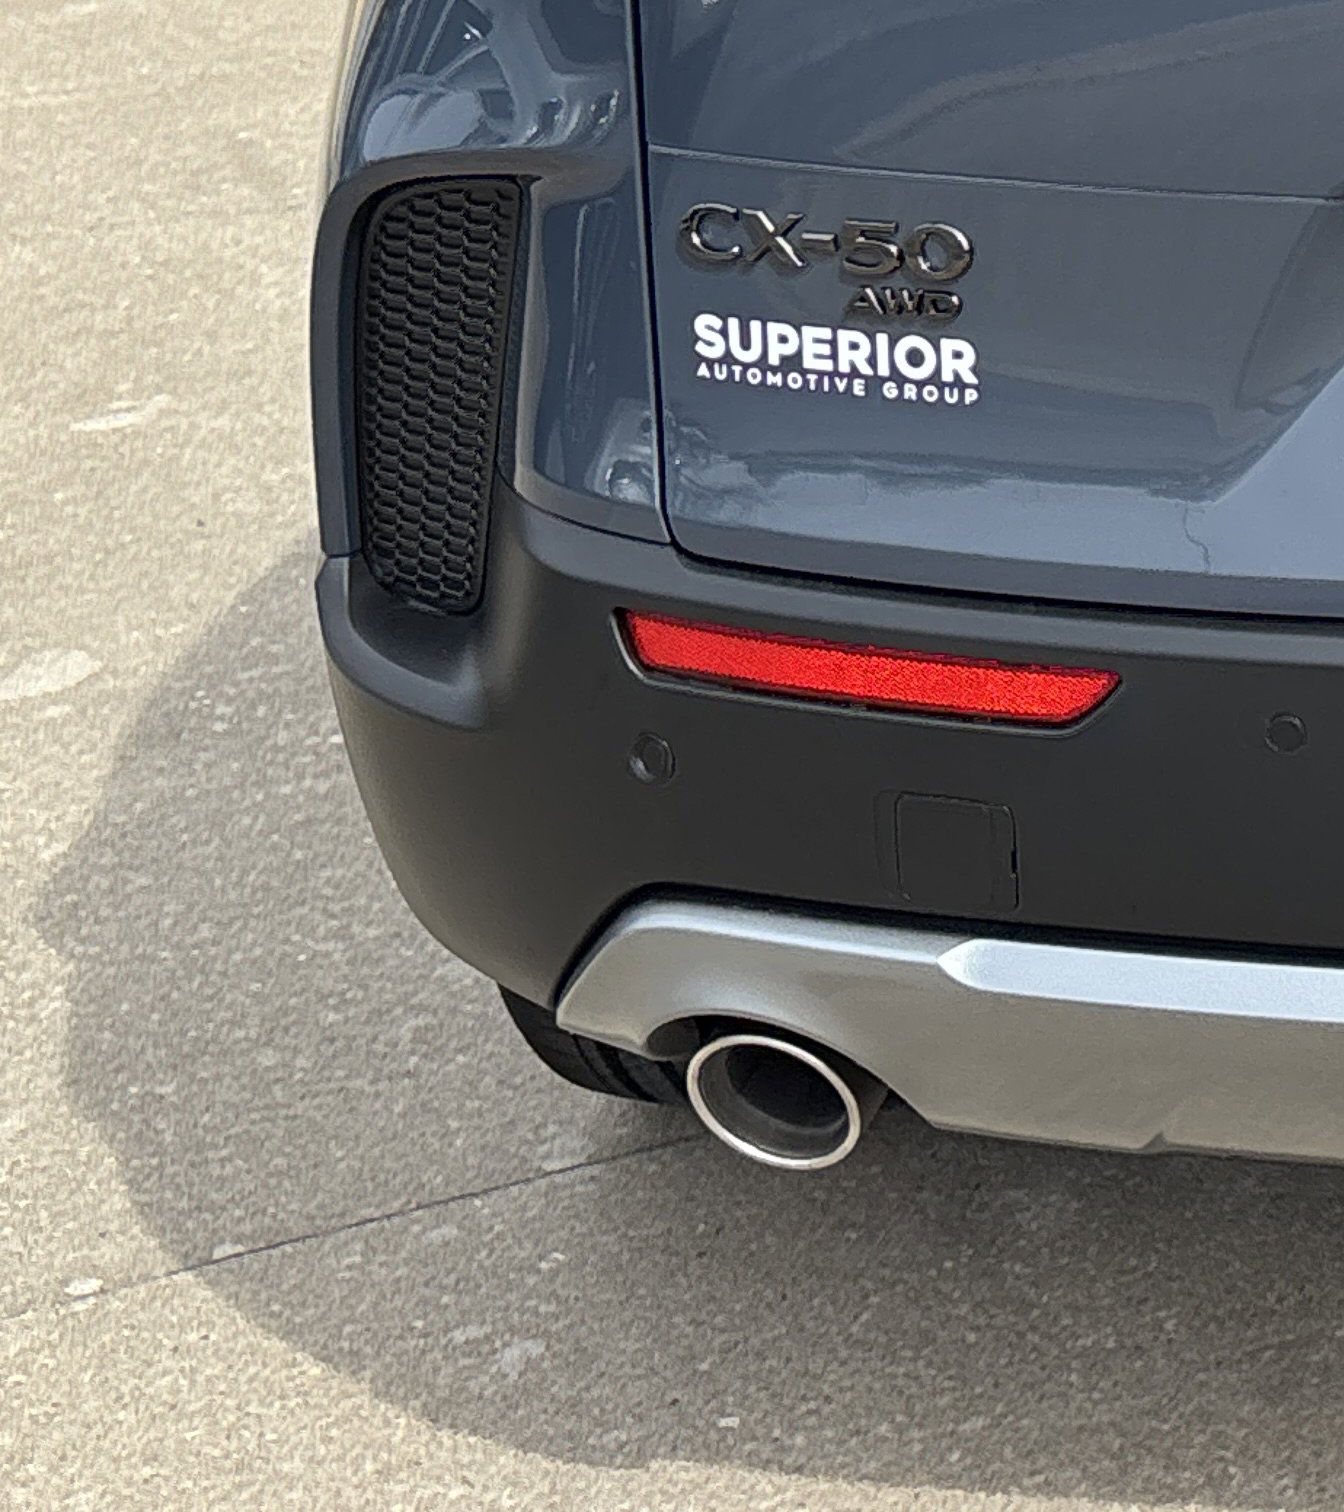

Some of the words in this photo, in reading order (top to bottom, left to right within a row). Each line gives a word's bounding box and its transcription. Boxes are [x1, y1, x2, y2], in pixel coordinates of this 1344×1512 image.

[680, 202, 975, 282] CX-50
[850, 285, 964, 321] AWD
[692, 312, 980, 386] SUPERIOR
[695, 360, 867, 397] AUTOMOTIVE
[881, 380, 981, 407] GROUP
